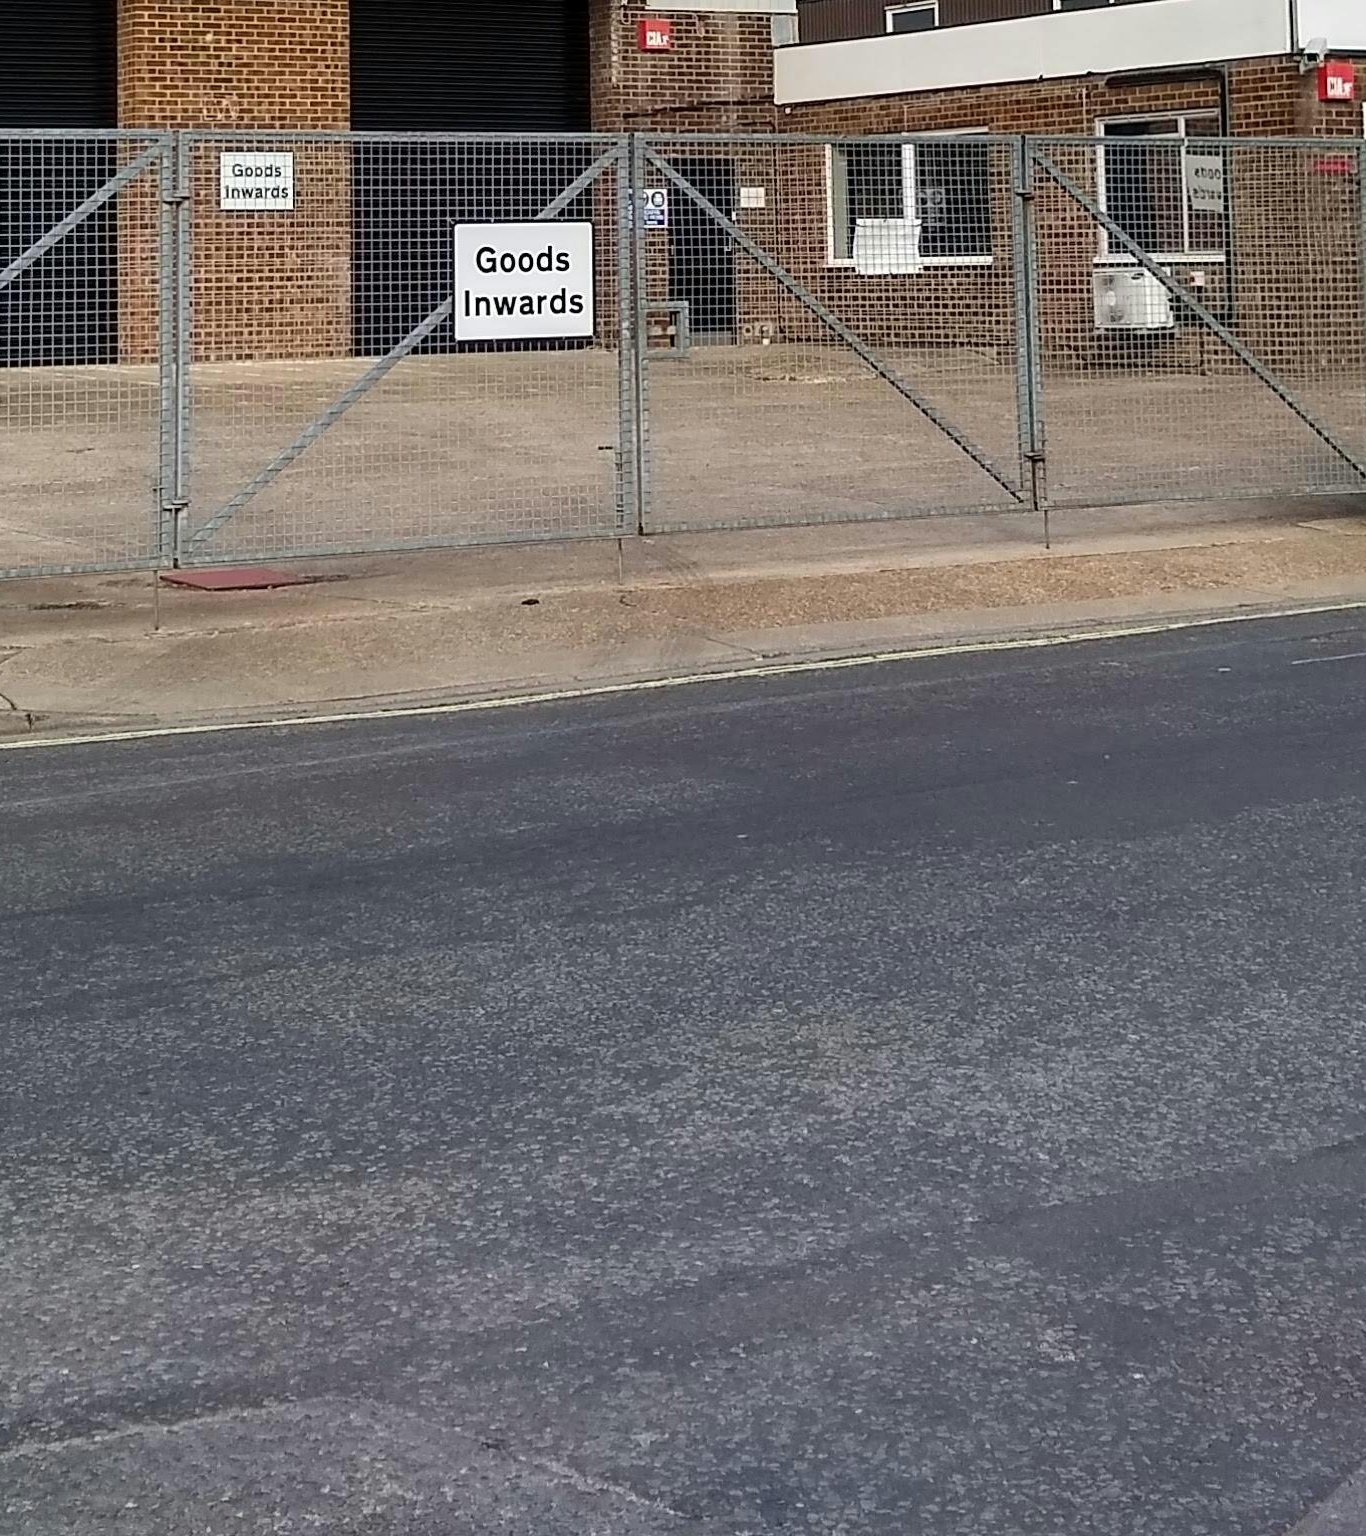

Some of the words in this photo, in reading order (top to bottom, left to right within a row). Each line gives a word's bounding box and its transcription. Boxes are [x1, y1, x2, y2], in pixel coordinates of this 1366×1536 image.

[231, 163, 283, 178] Goods
[224, 184, 290, 199] Inwards
[475, 245, 571, 274] Goods
[464, 287, 585, 317] Inwards
